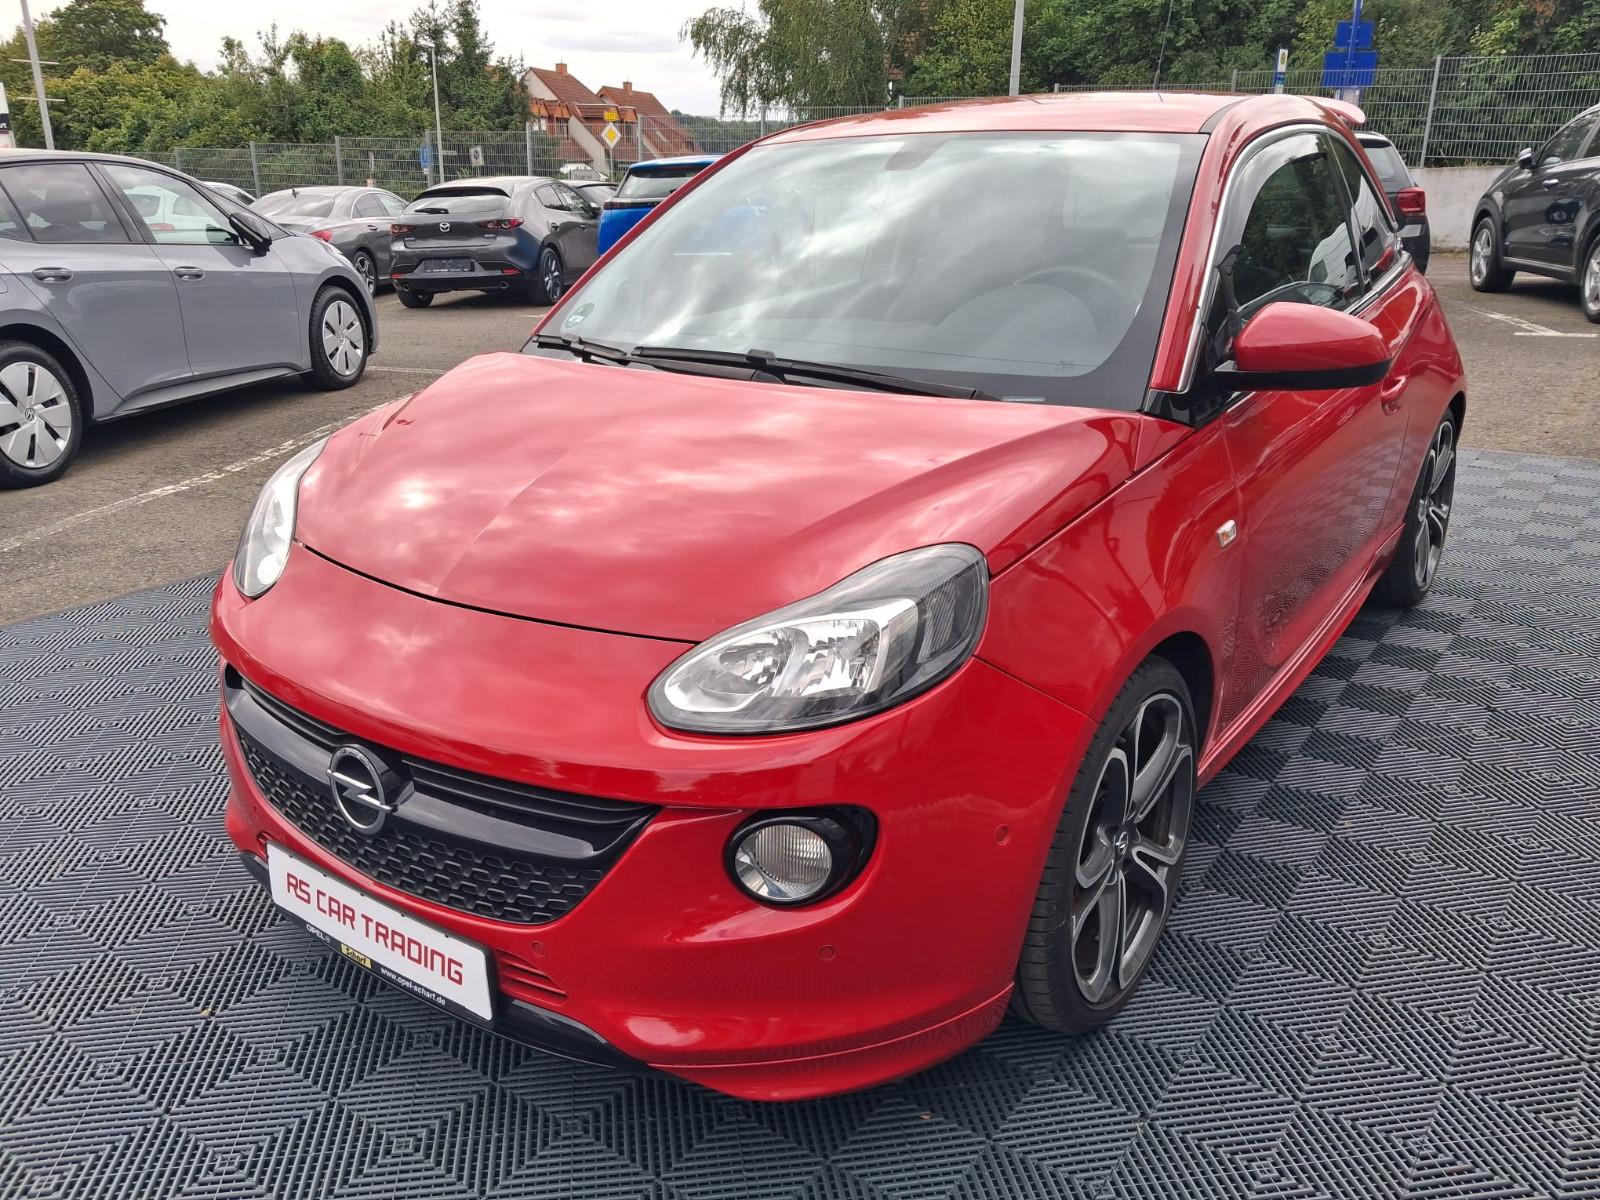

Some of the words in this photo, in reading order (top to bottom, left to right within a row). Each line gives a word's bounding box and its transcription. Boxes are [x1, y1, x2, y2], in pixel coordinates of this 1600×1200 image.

[286, 872, 311, 905] RS
[316, 889, 356, 930] CAR
[361, 912, 463, 985] TRADING
[306, 923, 326, 941] OPEL
[380, 967, 446, 1006] www.opel-scharf.de
